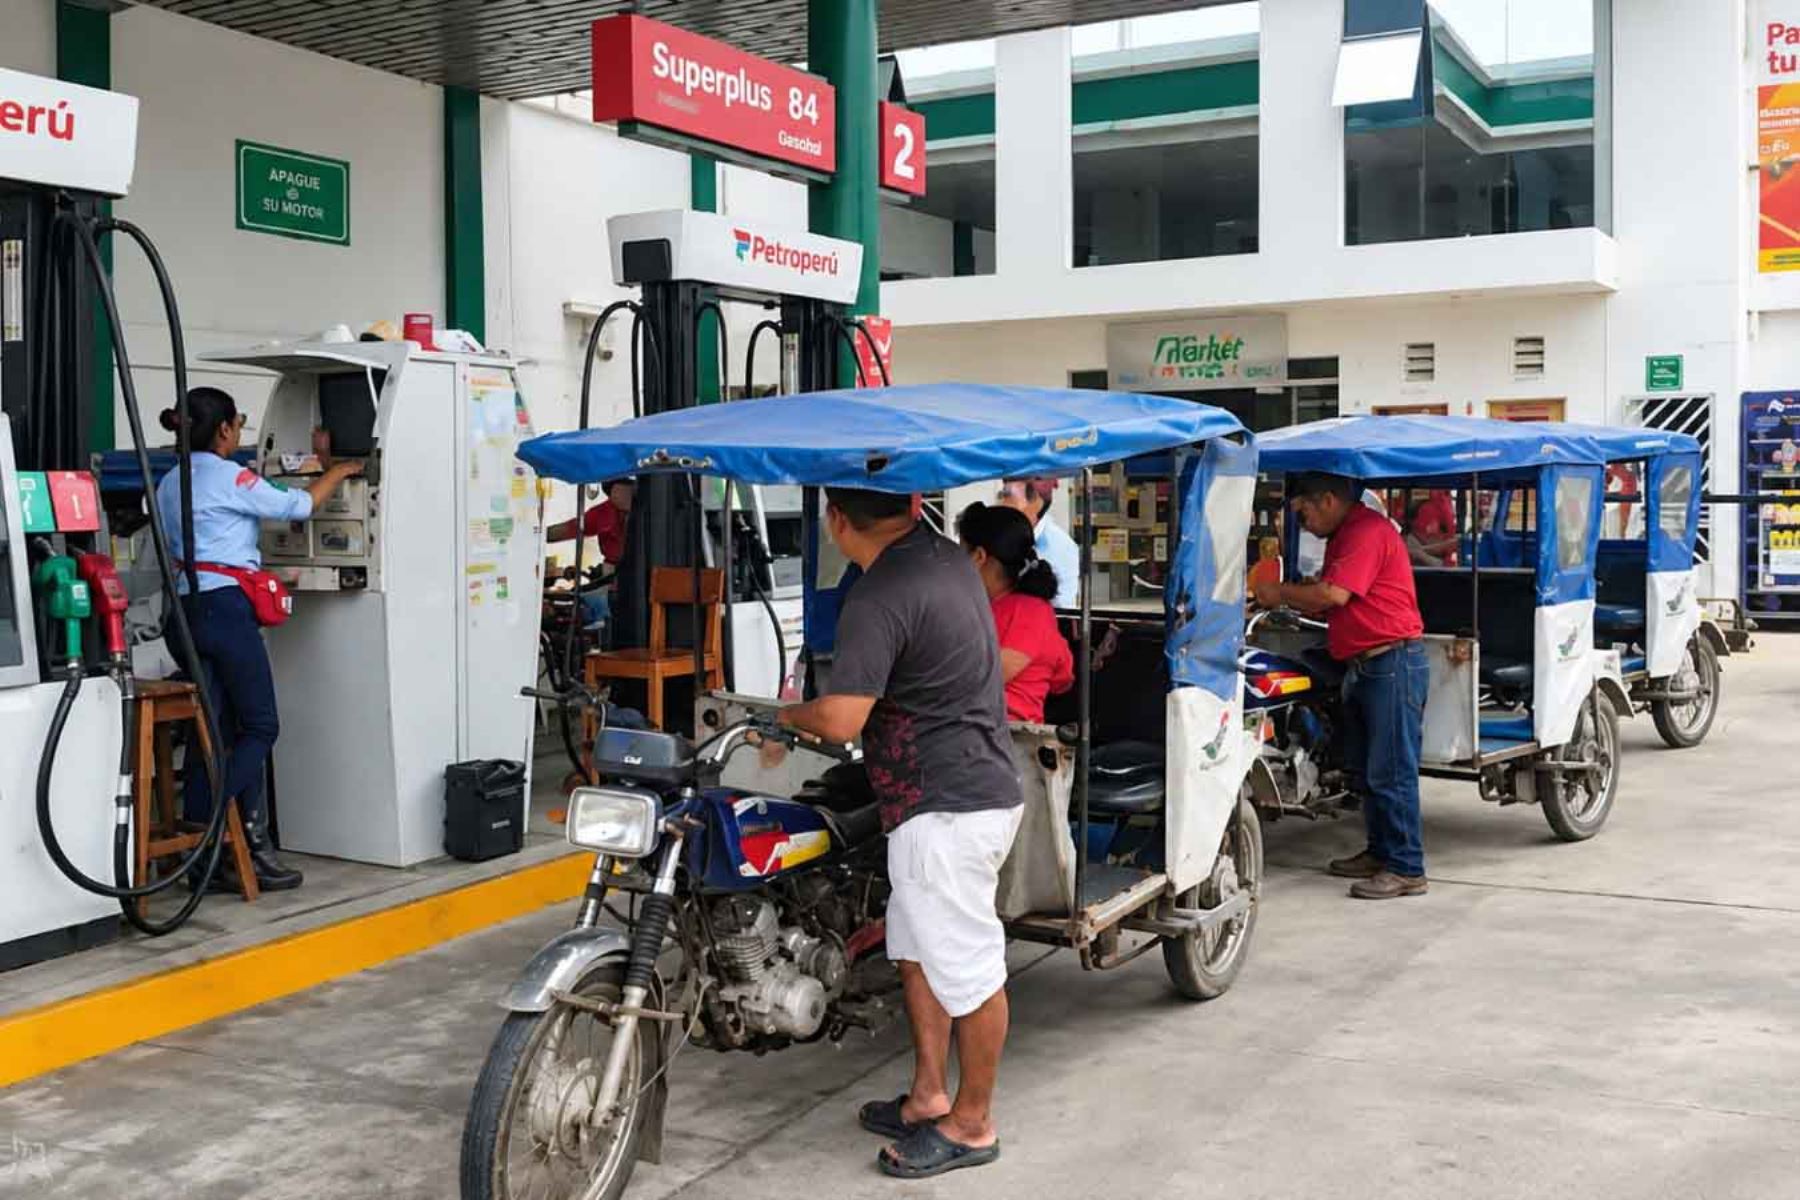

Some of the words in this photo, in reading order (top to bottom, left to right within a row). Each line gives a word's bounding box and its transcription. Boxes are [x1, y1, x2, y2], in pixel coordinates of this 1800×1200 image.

[1767, 51, 1796, 74] tu
[652, 41, 772, 111] Superplus
[788, 87, 818, 126] 84
[0, 101, 74, 141] erú
[893, 123, 915, 180] 2
[268, 168, 321, 190] APAGUE
[262, 198, 279, 213] SU
[281, 202, 324, 219] MOTOR
[752, 235, 838, 276] Petroperú
